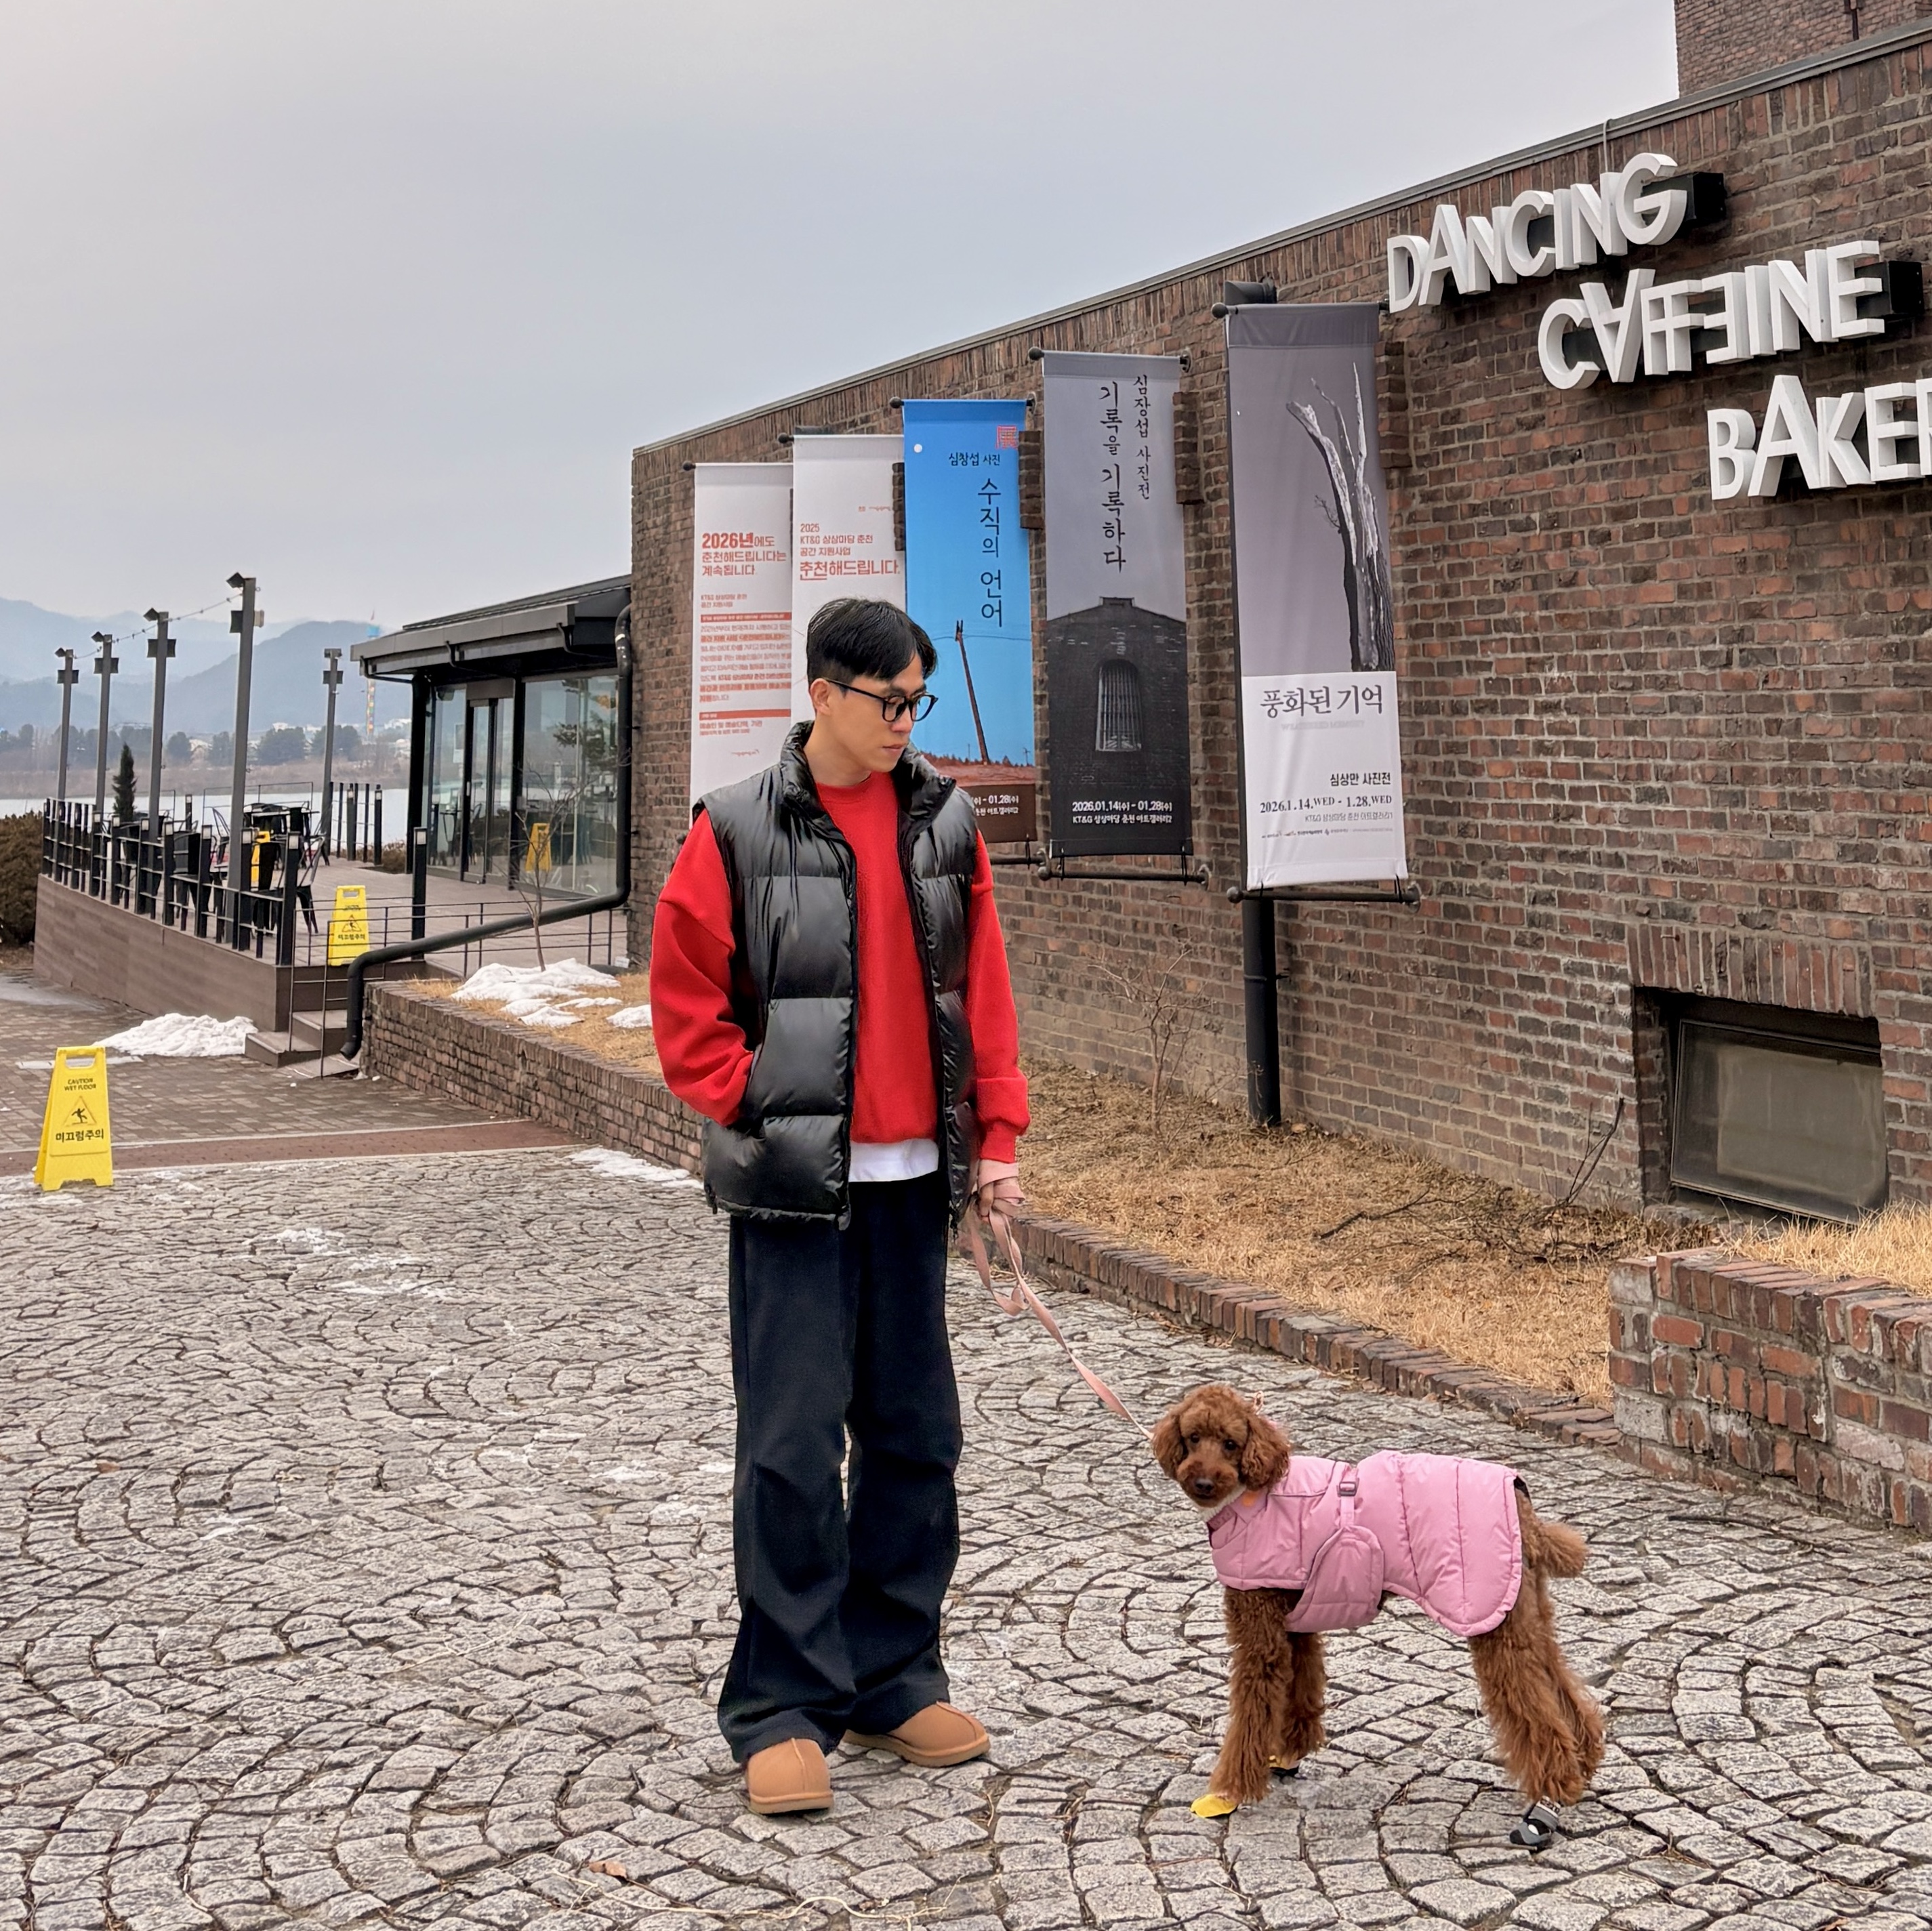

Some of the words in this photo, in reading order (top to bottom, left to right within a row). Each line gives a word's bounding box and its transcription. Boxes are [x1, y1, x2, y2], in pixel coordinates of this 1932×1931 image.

[1387, 152, 1687, 313] DANCING
[1099, 381, 1123, 455] 기록을
[983, 453, 1001, 466] 사진
[1136, 445, 1151, 500] 사진전
[978, 478, 1002, 558] 수직의
[1102, 463, 1126, 574] 기록하다
[800, 523, 820, 533] 2025
[702, 533, 775, 549] 2026년에도
[800, 535, 820, 544] KT&G
[823, 535, 855, 544] 상상마당
[857, 535, 873, 543] 춘천
[702, 551, 786, 563] 춘천해드립니다는
[800, 547, 816, 556] 공간
[819, 547, 851, 556] 지원사업
[800, 560, 900, 581] 춘천해드립니다.
[981, 569, 1002, 627] 언어
[1260, 686, 1332, 718] 풍화된
[1336, 684, 1383, 715] 기억
[1330, 772, 1359, 787] 심상만
[1362, 772, 1391, 785] 사진전
[1072, 801, 1130, 812] 2026.01.14(수)
[1138, 800, 1172, 812] 01.28(수)
[1073, 816, 1093, 824] KT&G
[1094, 814, 1120, 824] 상상마당
[56, 1128, 104, 1143] 미끄럼주의
